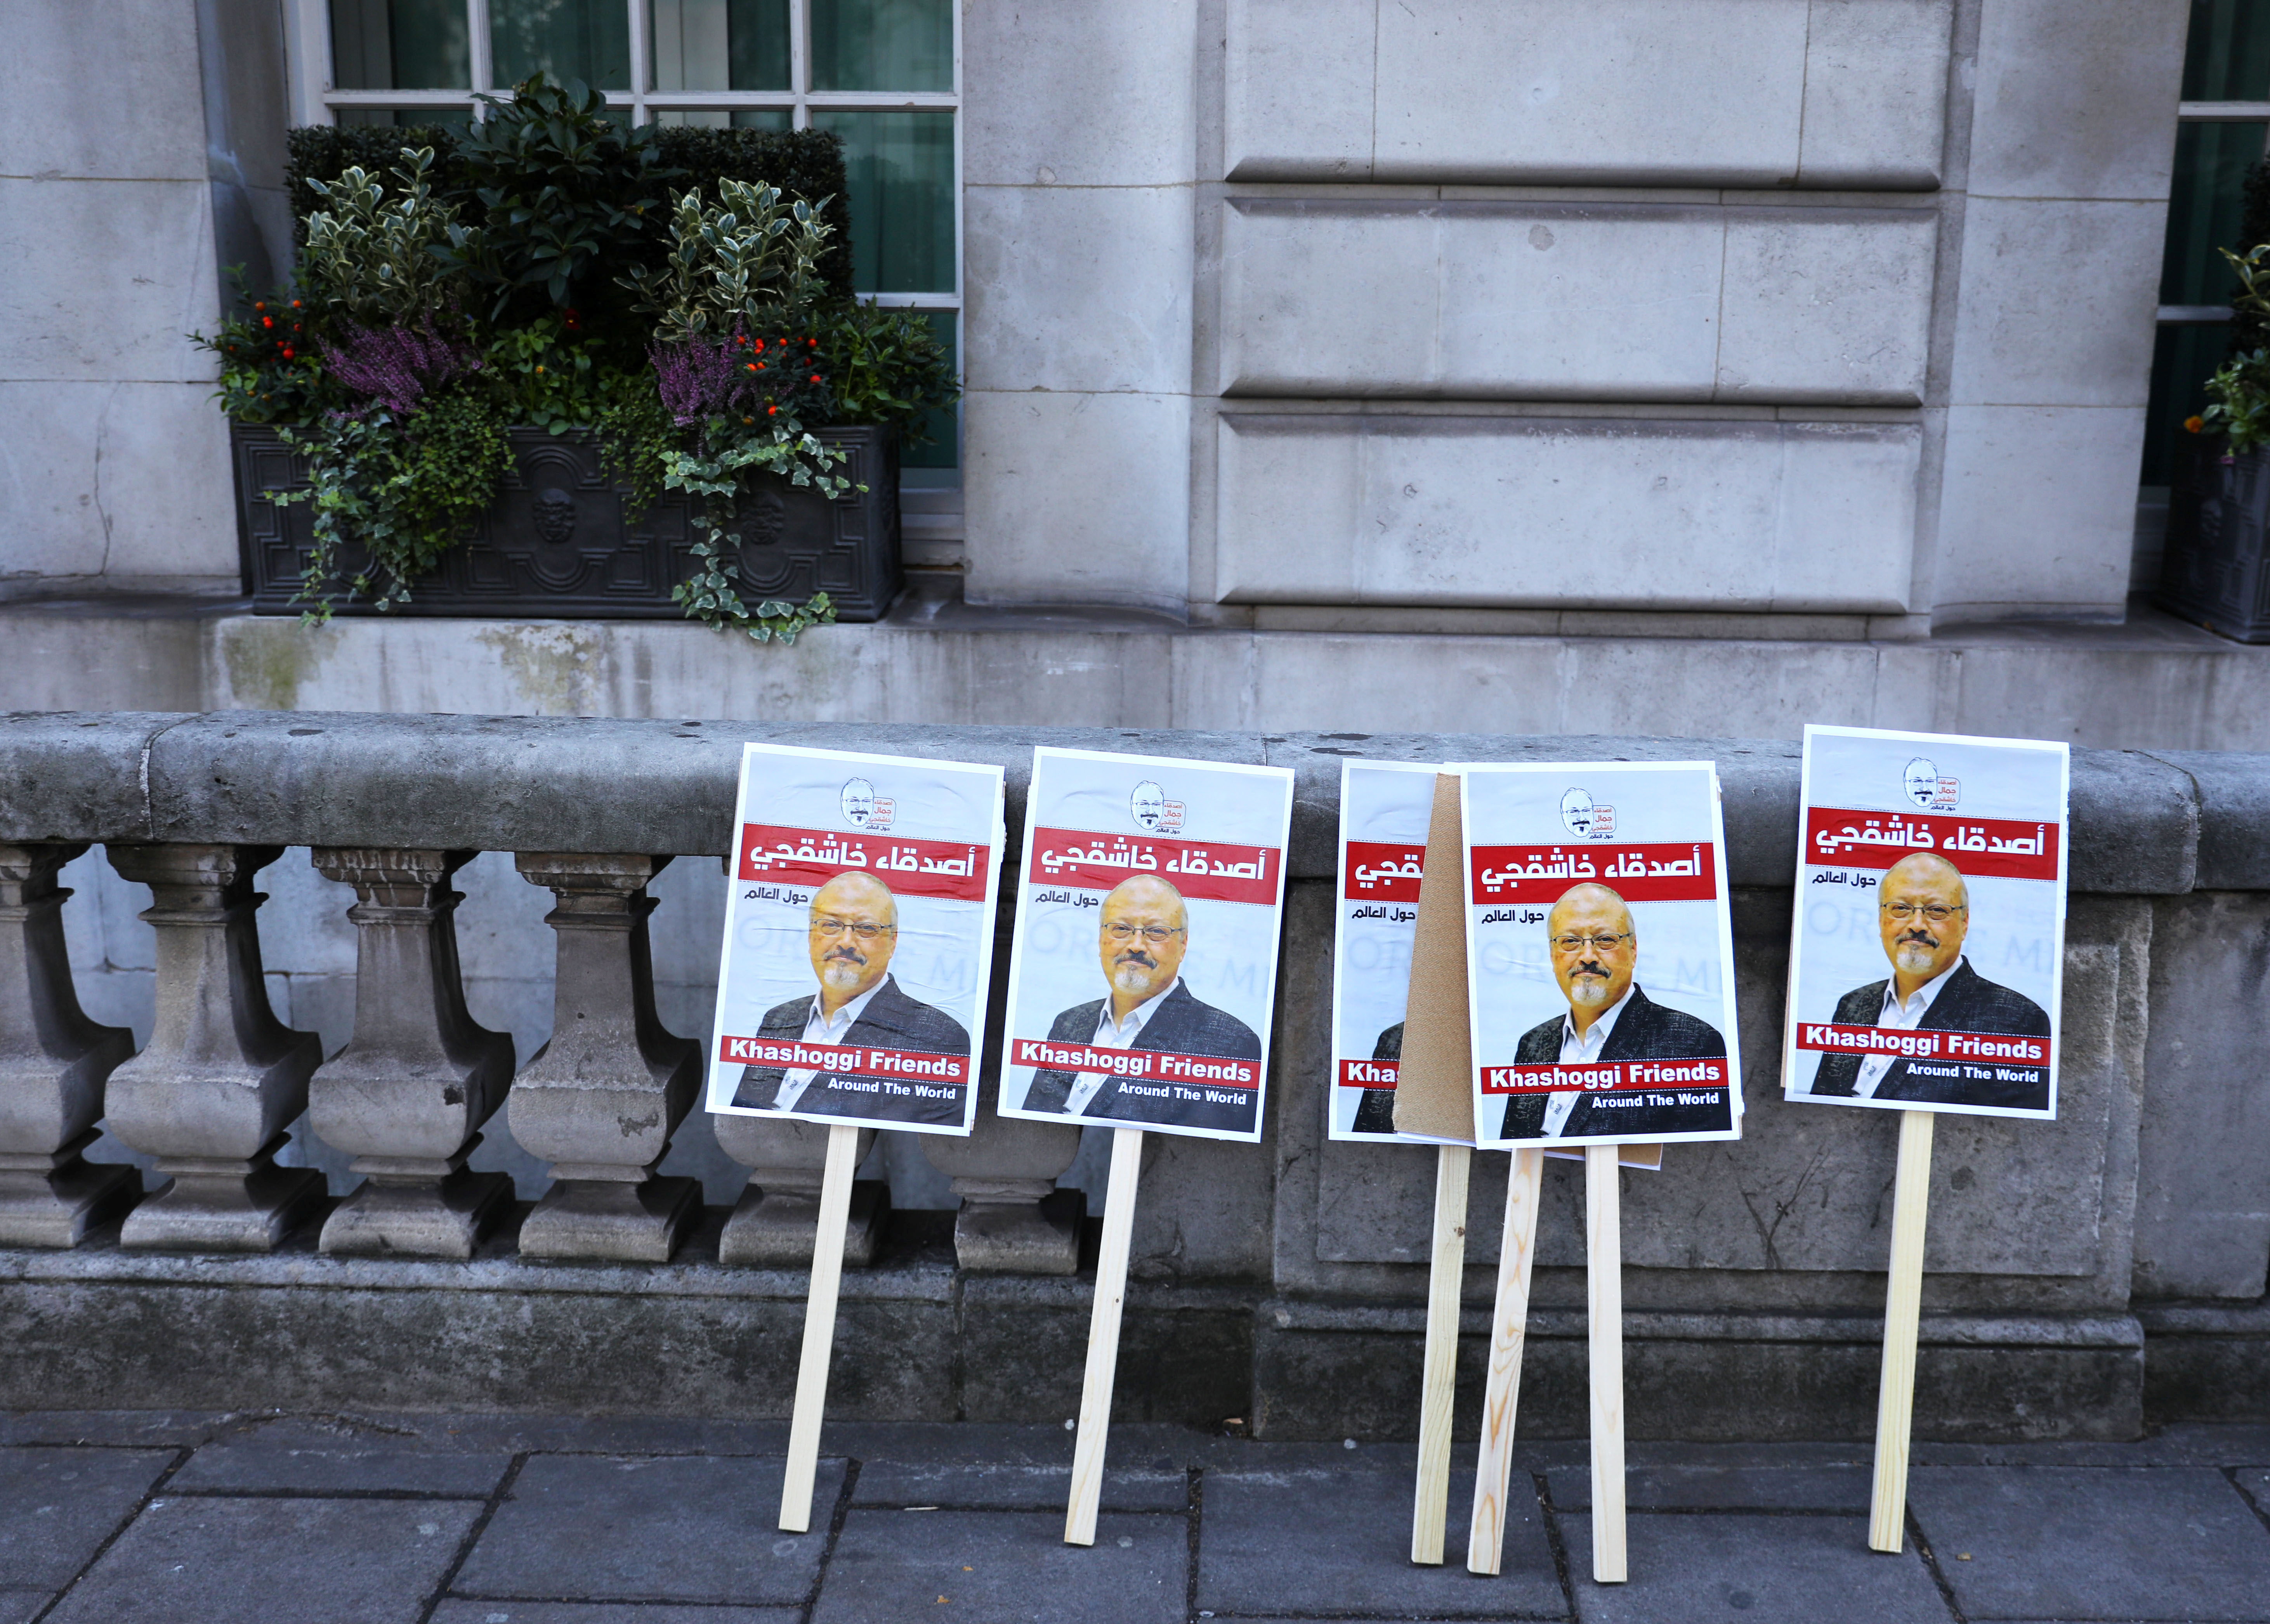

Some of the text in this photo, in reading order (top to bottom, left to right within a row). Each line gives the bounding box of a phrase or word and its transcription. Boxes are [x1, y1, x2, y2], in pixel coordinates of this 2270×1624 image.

[1816, 815, 2044, 855] أصدقاء خاشقجي
[751, 834, 975, 876] أصدقاء خاشقجي
[1041, 837, 1265, 880] أصدقاء خاشقجي
[1481, 845, 1700, 892] أصدقاء خاشقجي
[1812, 871, 1876, 888] حول العالم
[745, 887, 808, 904] حول العالم
[1035, 891, 1098, 908] حول العالم
[1352, 906, 1415, 922] حول العالم
[1482, 910, 1544, 924] حول العالم
[1806, 1025, 2041, 1059] Khashoggi Friends
[730, 1039, 960, 1076] Khashoggi Friends
[1021, 1043, 1251, 1083] Khashoggi Friends
[1491, 1063, 1719, 1089] Khashoggi Friends
[1907, 1063, 2038, 1082] Around The World
[828, 1077, 955, 1099] Around The World
[1118, 1081, 1247, 1105] Around The World
[1592, 1093, 1719, 1108] Around The World
